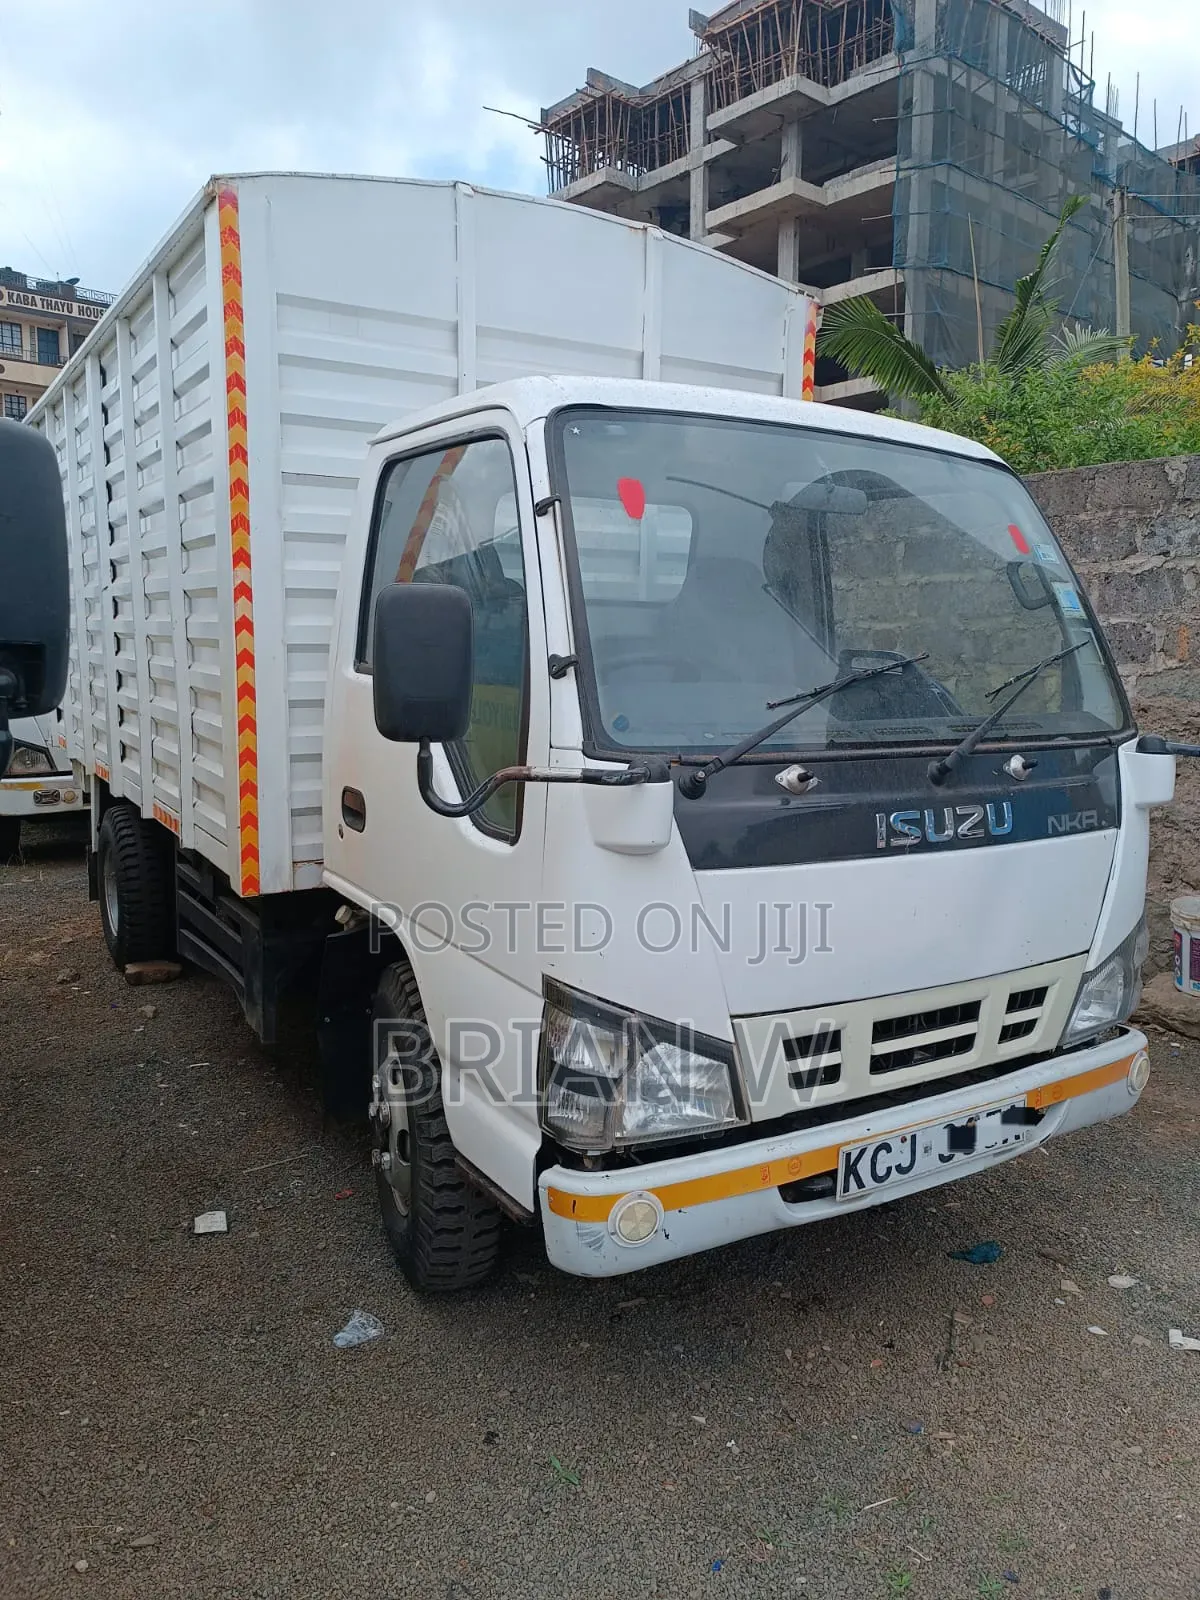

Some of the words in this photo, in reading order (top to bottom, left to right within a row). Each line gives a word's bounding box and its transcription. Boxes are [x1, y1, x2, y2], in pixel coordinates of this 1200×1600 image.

[7, 291, 38, 308] KABA
[39, 298, 74, 314] THAYU
[77, 305, 107, 319] HOUS
[875, 801, 1013, 849] ISUZU
[843, 1133, 917, 1194] KCJ
